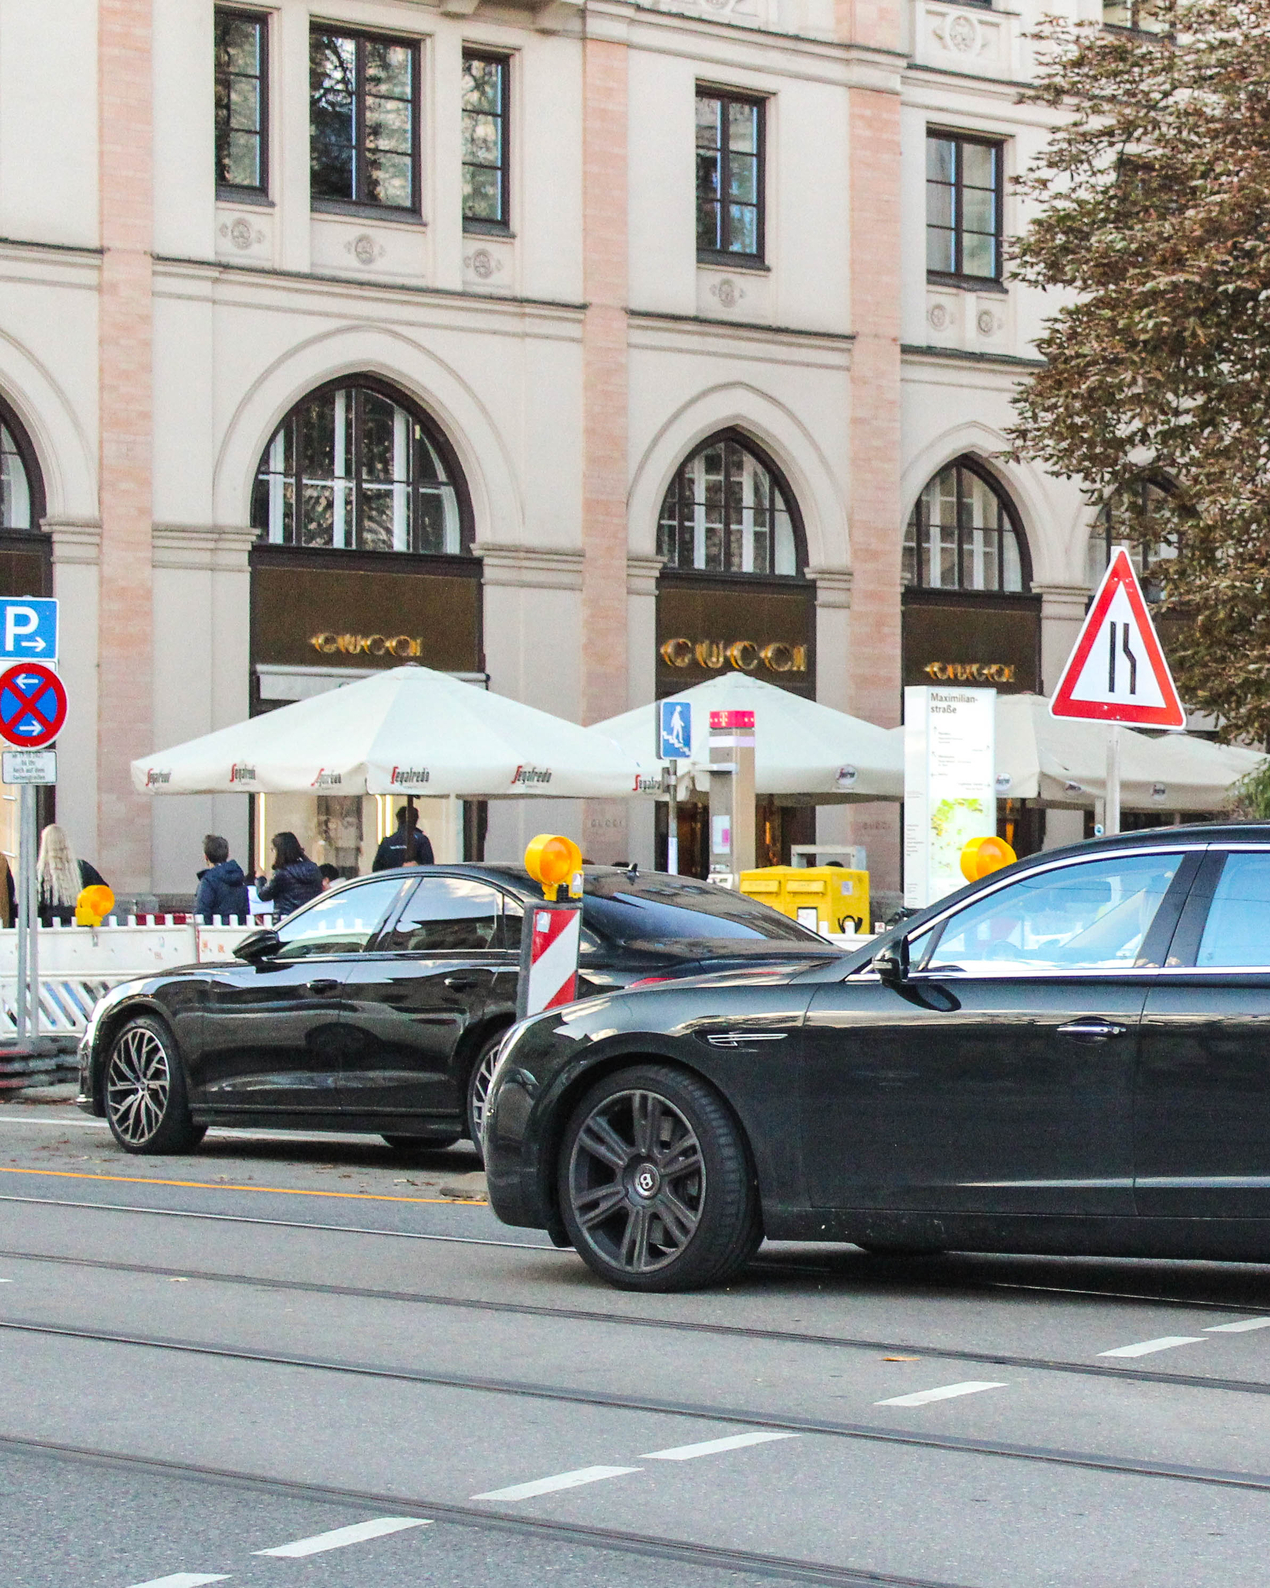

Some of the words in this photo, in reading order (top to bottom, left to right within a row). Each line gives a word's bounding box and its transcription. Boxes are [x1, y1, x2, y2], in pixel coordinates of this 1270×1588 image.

[5, 606, 40, 651] P
[309, 632, 422, 657] GUCCI
[660, 638, 807, 671] GUCCI
[930, 692, 979, 704] Maximilian-
[930, 705, 958, 715] straße
[390, 766, 430, 785] Segafredo
[511, 765, 553, 785] Segafredo
